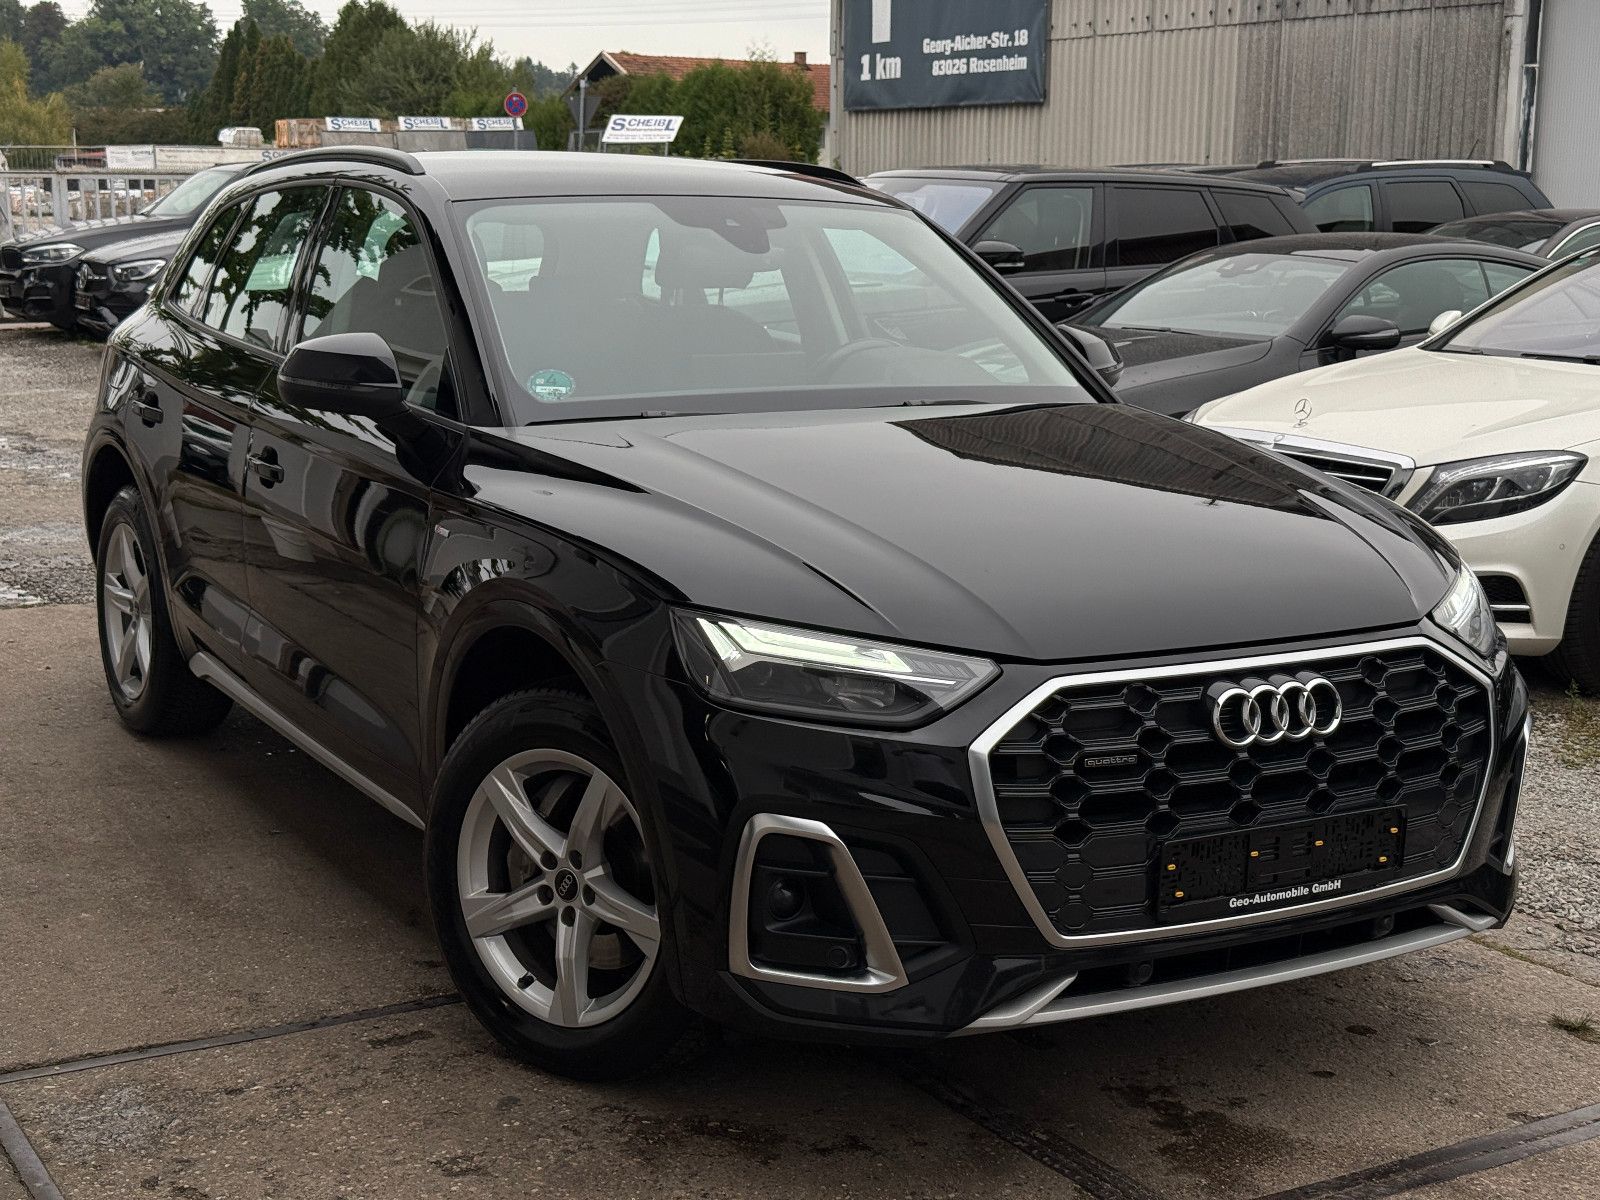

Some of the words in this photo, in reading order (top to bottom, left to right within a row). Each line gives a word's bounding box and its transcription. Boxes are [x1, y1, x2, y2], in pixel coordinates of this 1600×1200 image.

[922, 31, 1013, 56] Georg-Aicher-Str.
[1013, 29, 1028, 46] 18
[860, 54, 872, 81] 1
[875, 53, 902, 80] km
[932, 59, 967, 76] 83026
[968, 55, 1028, 73] Rosenheim
[1087, 756, 1136, 767] quattro
[1229, 886, 1310, 908] Geo-Automobile
[1312, 879, 1342, 894] GmbH
